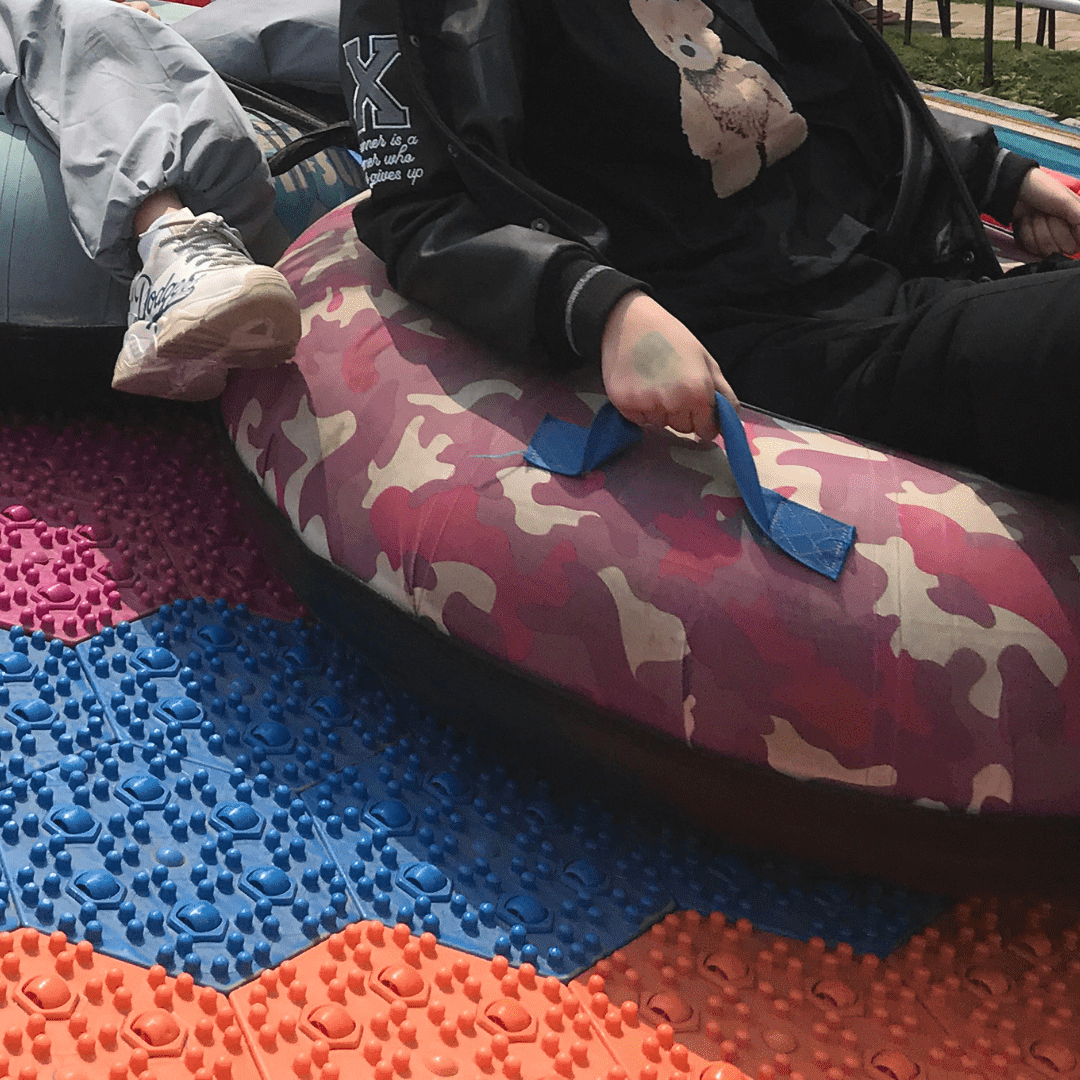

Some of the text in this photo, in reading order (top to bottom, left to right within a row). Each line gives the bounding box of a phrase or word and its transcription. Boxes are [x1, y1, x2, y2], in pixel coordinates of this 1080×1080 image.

[390, 133, 402, 146] is
[407, 135, 420, 145] a
[384, 144, 416, 165] who
[369, 169, 402, 189] gives
[406, 168, 424, 186] up
